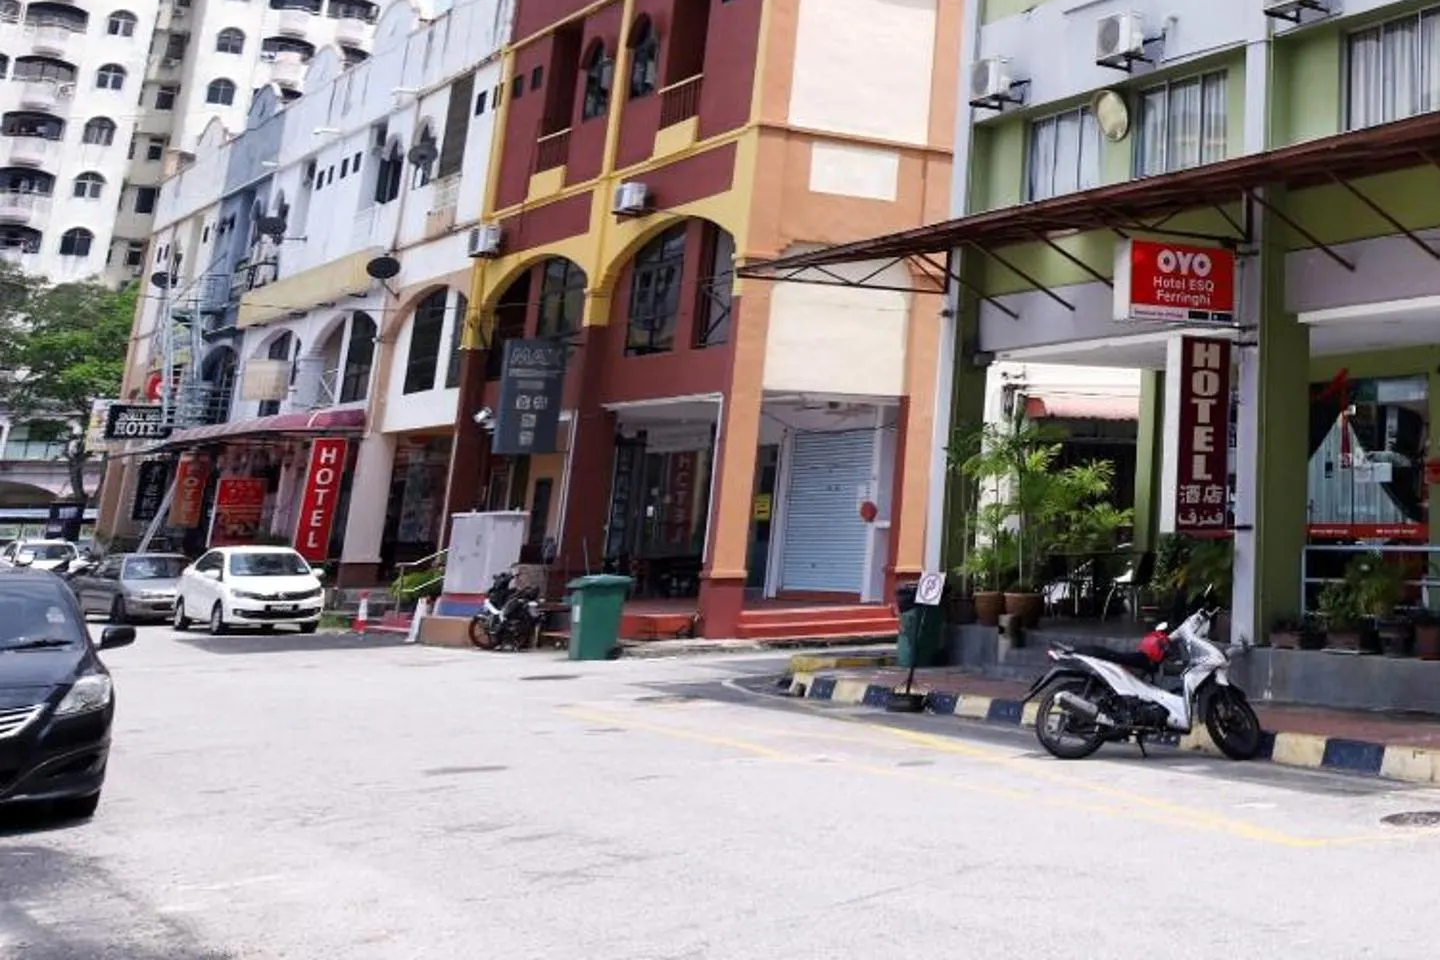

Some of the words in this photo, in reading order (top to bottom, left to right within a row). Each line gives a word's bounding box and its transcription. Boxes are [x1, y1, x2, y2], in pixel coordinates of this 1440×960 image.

[1156, 248, 1212, 277] OYO
[1153, 276, 1186, 290] Hotel
[1189, 279, 1215, 293] ESQ
[1156, 289, 1212, 306] Ferringhi
[1190, 342, 1221, 482] HOTEL
[306, 447, 337, 549] HOTEL
[1179, 483, 1224, 505] 酒店
